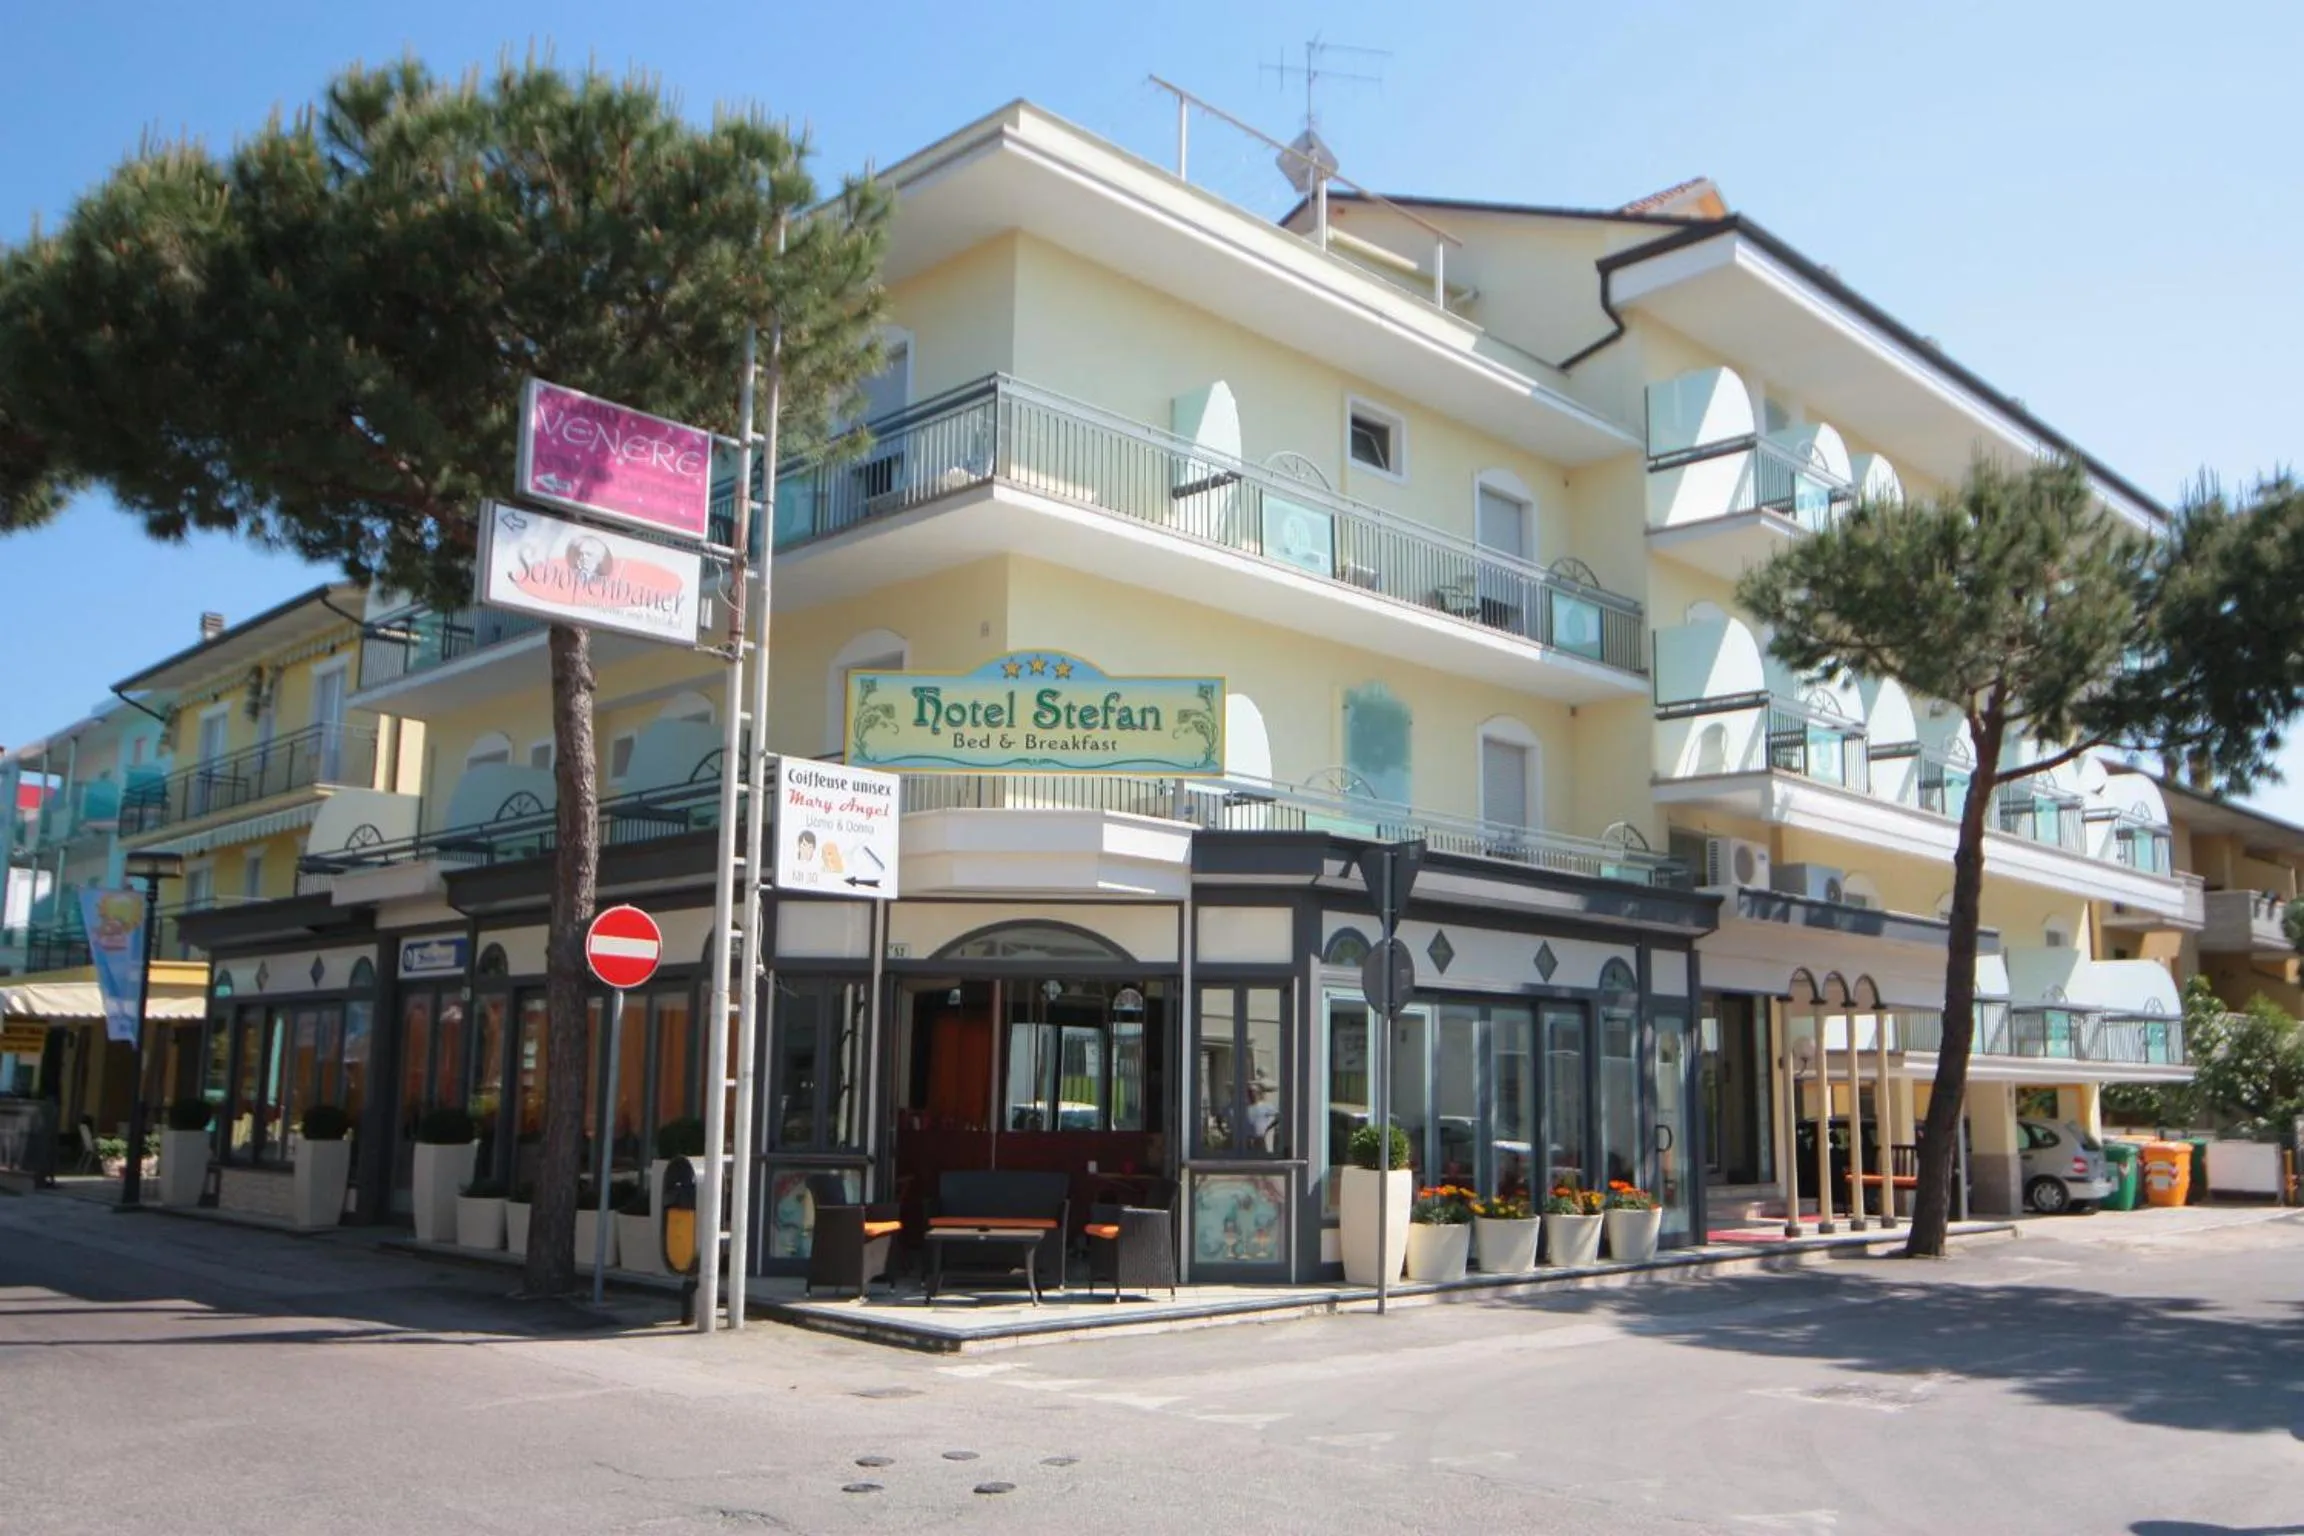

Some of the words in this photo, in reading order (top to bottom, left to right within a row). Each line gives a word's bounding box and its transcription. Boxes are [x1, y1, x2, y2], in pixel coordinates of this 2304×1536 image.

[537, 403, 702, 477] VENERE
[911, 685, 1016, 735] Hotel
[1033, 687, 1163, 731] Stefan
[953, 733, 991, 750] Bed
[999, 734, 1016, 750] &
[1025, 733, 1118, 751] Breakfast
[788, 767, 848, 791] Coiffeuse
[852, 778, 891, 796] unisex
[788, 789, 832, 814] Mary
[839, 796, 889, 820] Angel
